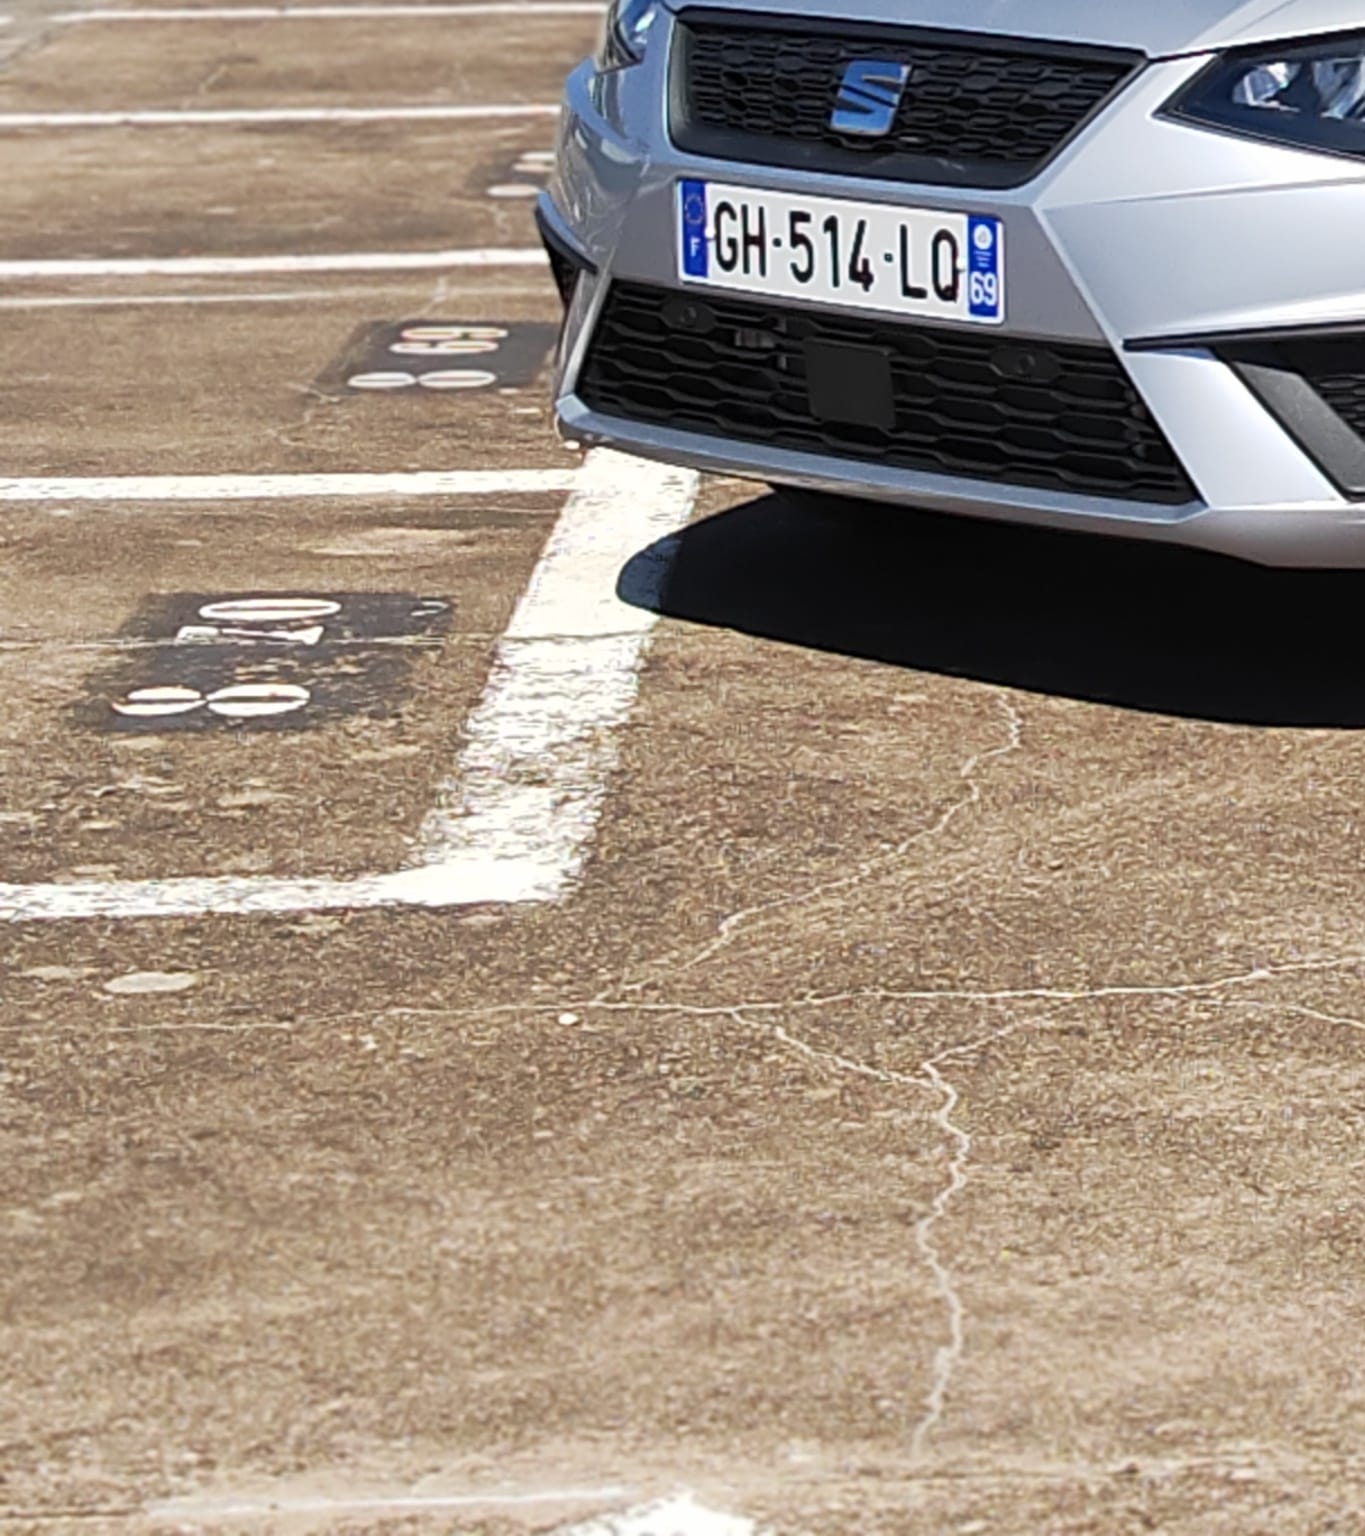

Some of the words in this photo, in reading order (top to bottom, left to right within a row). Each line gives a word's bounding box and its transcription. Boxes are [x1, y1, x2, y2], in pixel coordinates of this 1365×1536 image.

[690, 236, 701, 257] F
[714, 200, 959, 304] GH-514-LQ
[971, 271, 997, 306] 69
